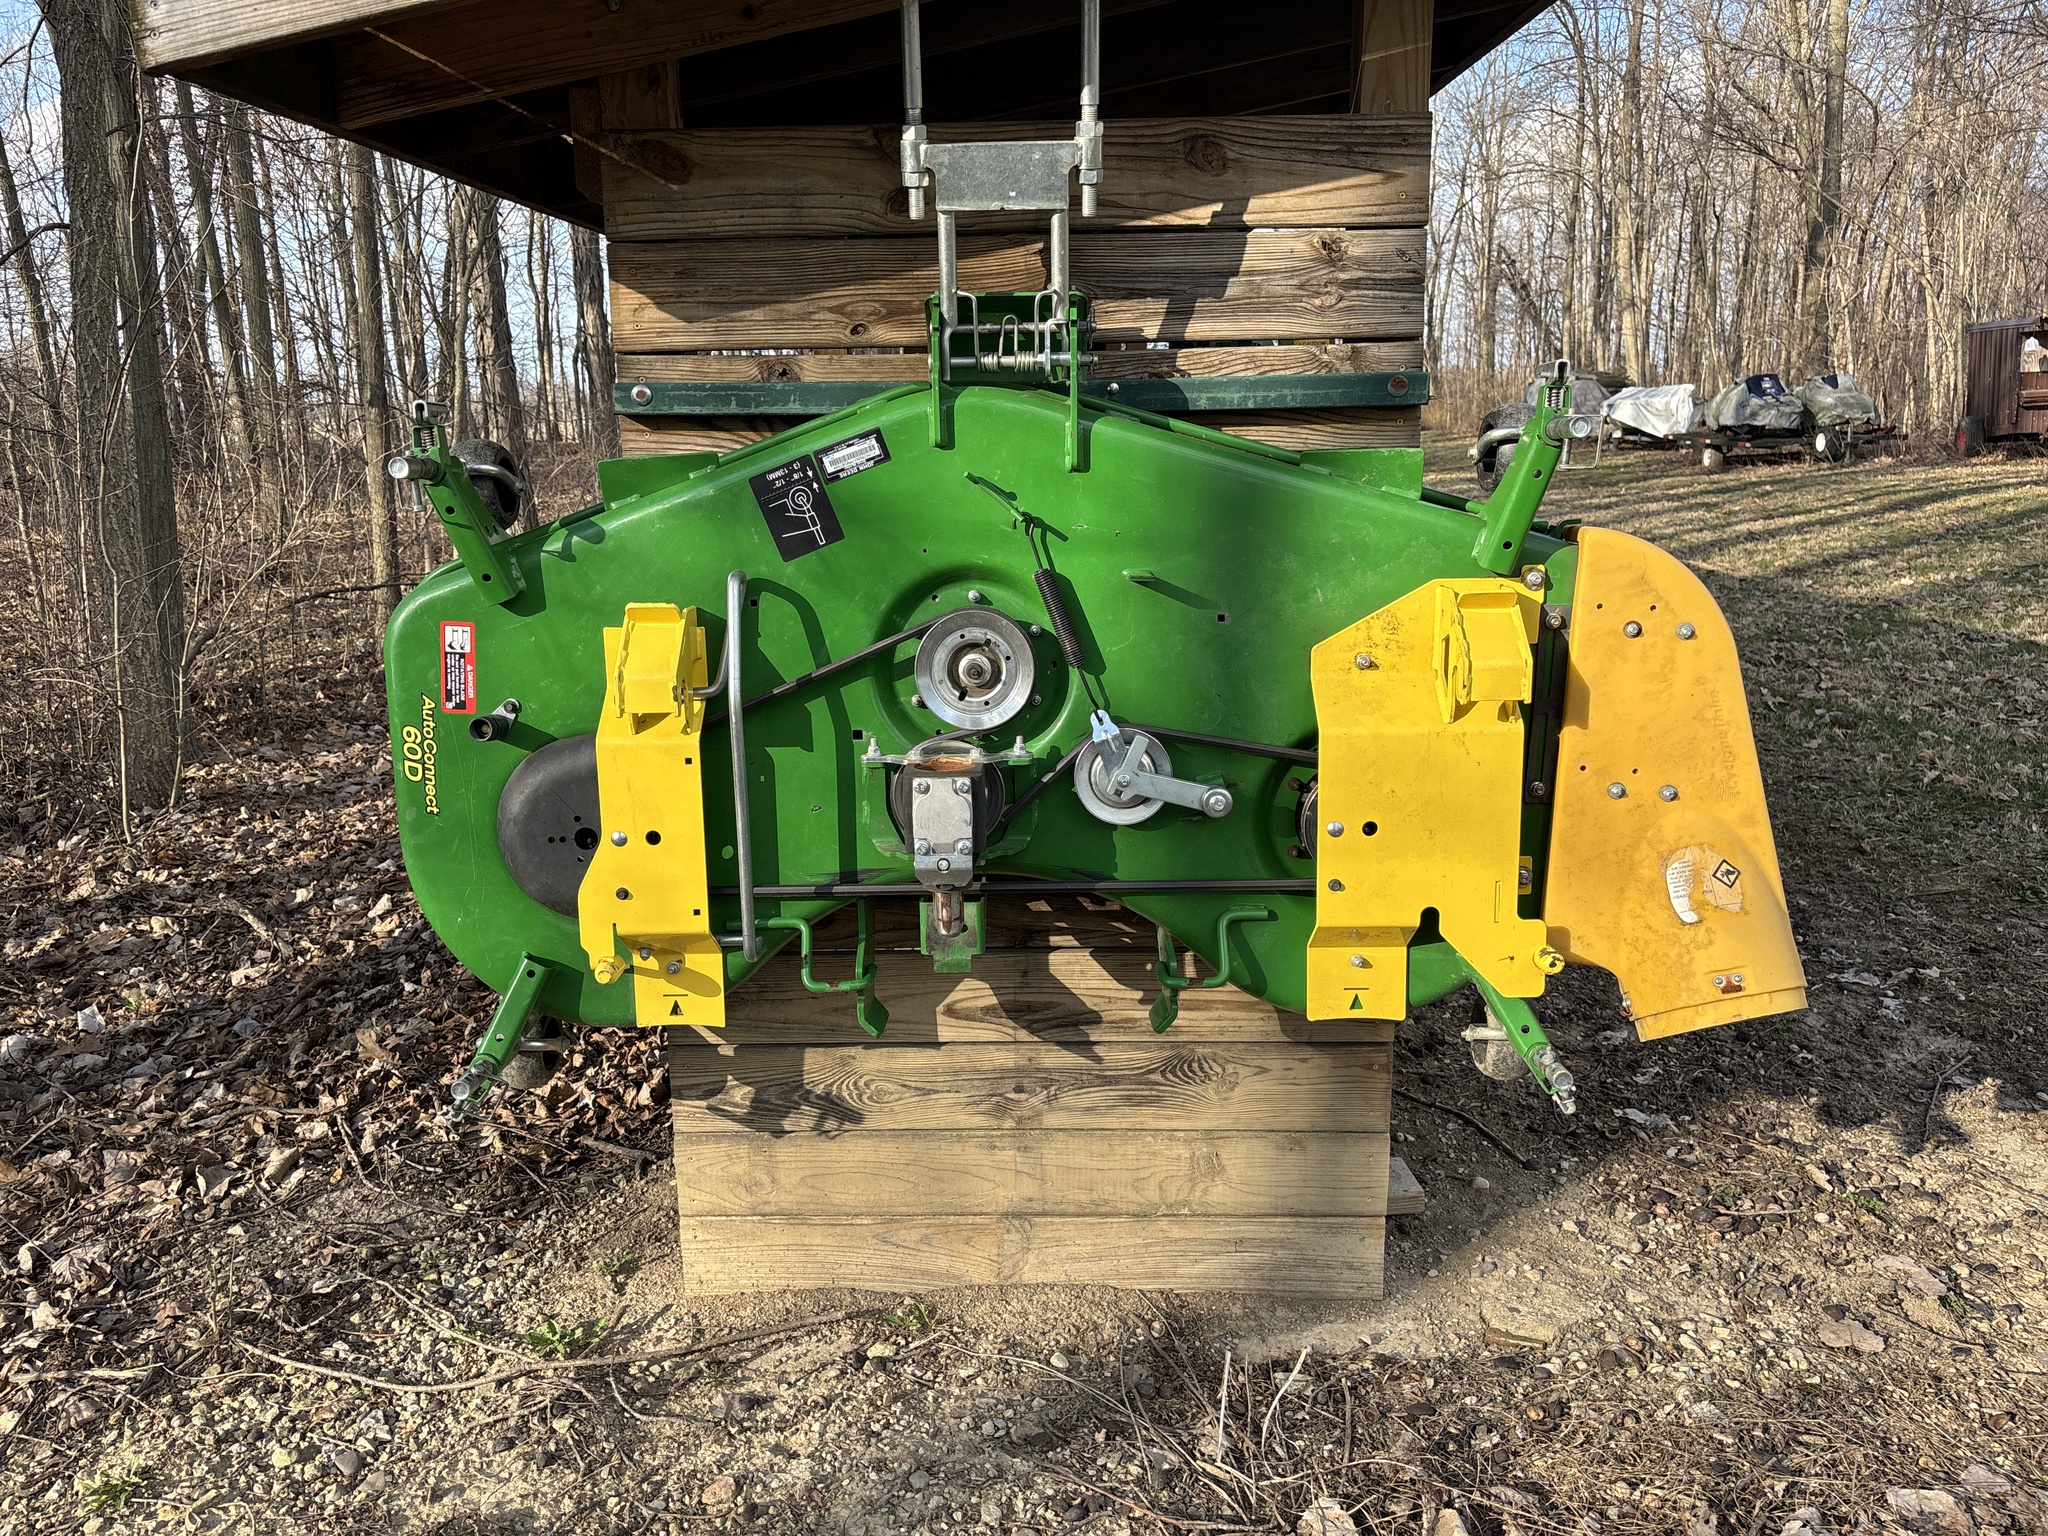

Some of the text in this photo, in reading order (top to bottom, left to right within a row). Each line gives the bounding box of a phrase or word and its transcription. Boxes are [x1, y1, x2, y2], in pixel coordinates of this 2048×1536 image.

[793, 461, 801, 470] (3
[859, 460, 875, 471] JOHN
[766, 467, 789, 481] 13MM)
[791, 471, 804, 482] 1/8"
[839, 467, 858, 478] DEERE
[773, 478, 786, 489] 1/2"
[402, 725, 423, 783] 60D
[421, 694, 440, 815] AutoConnect
